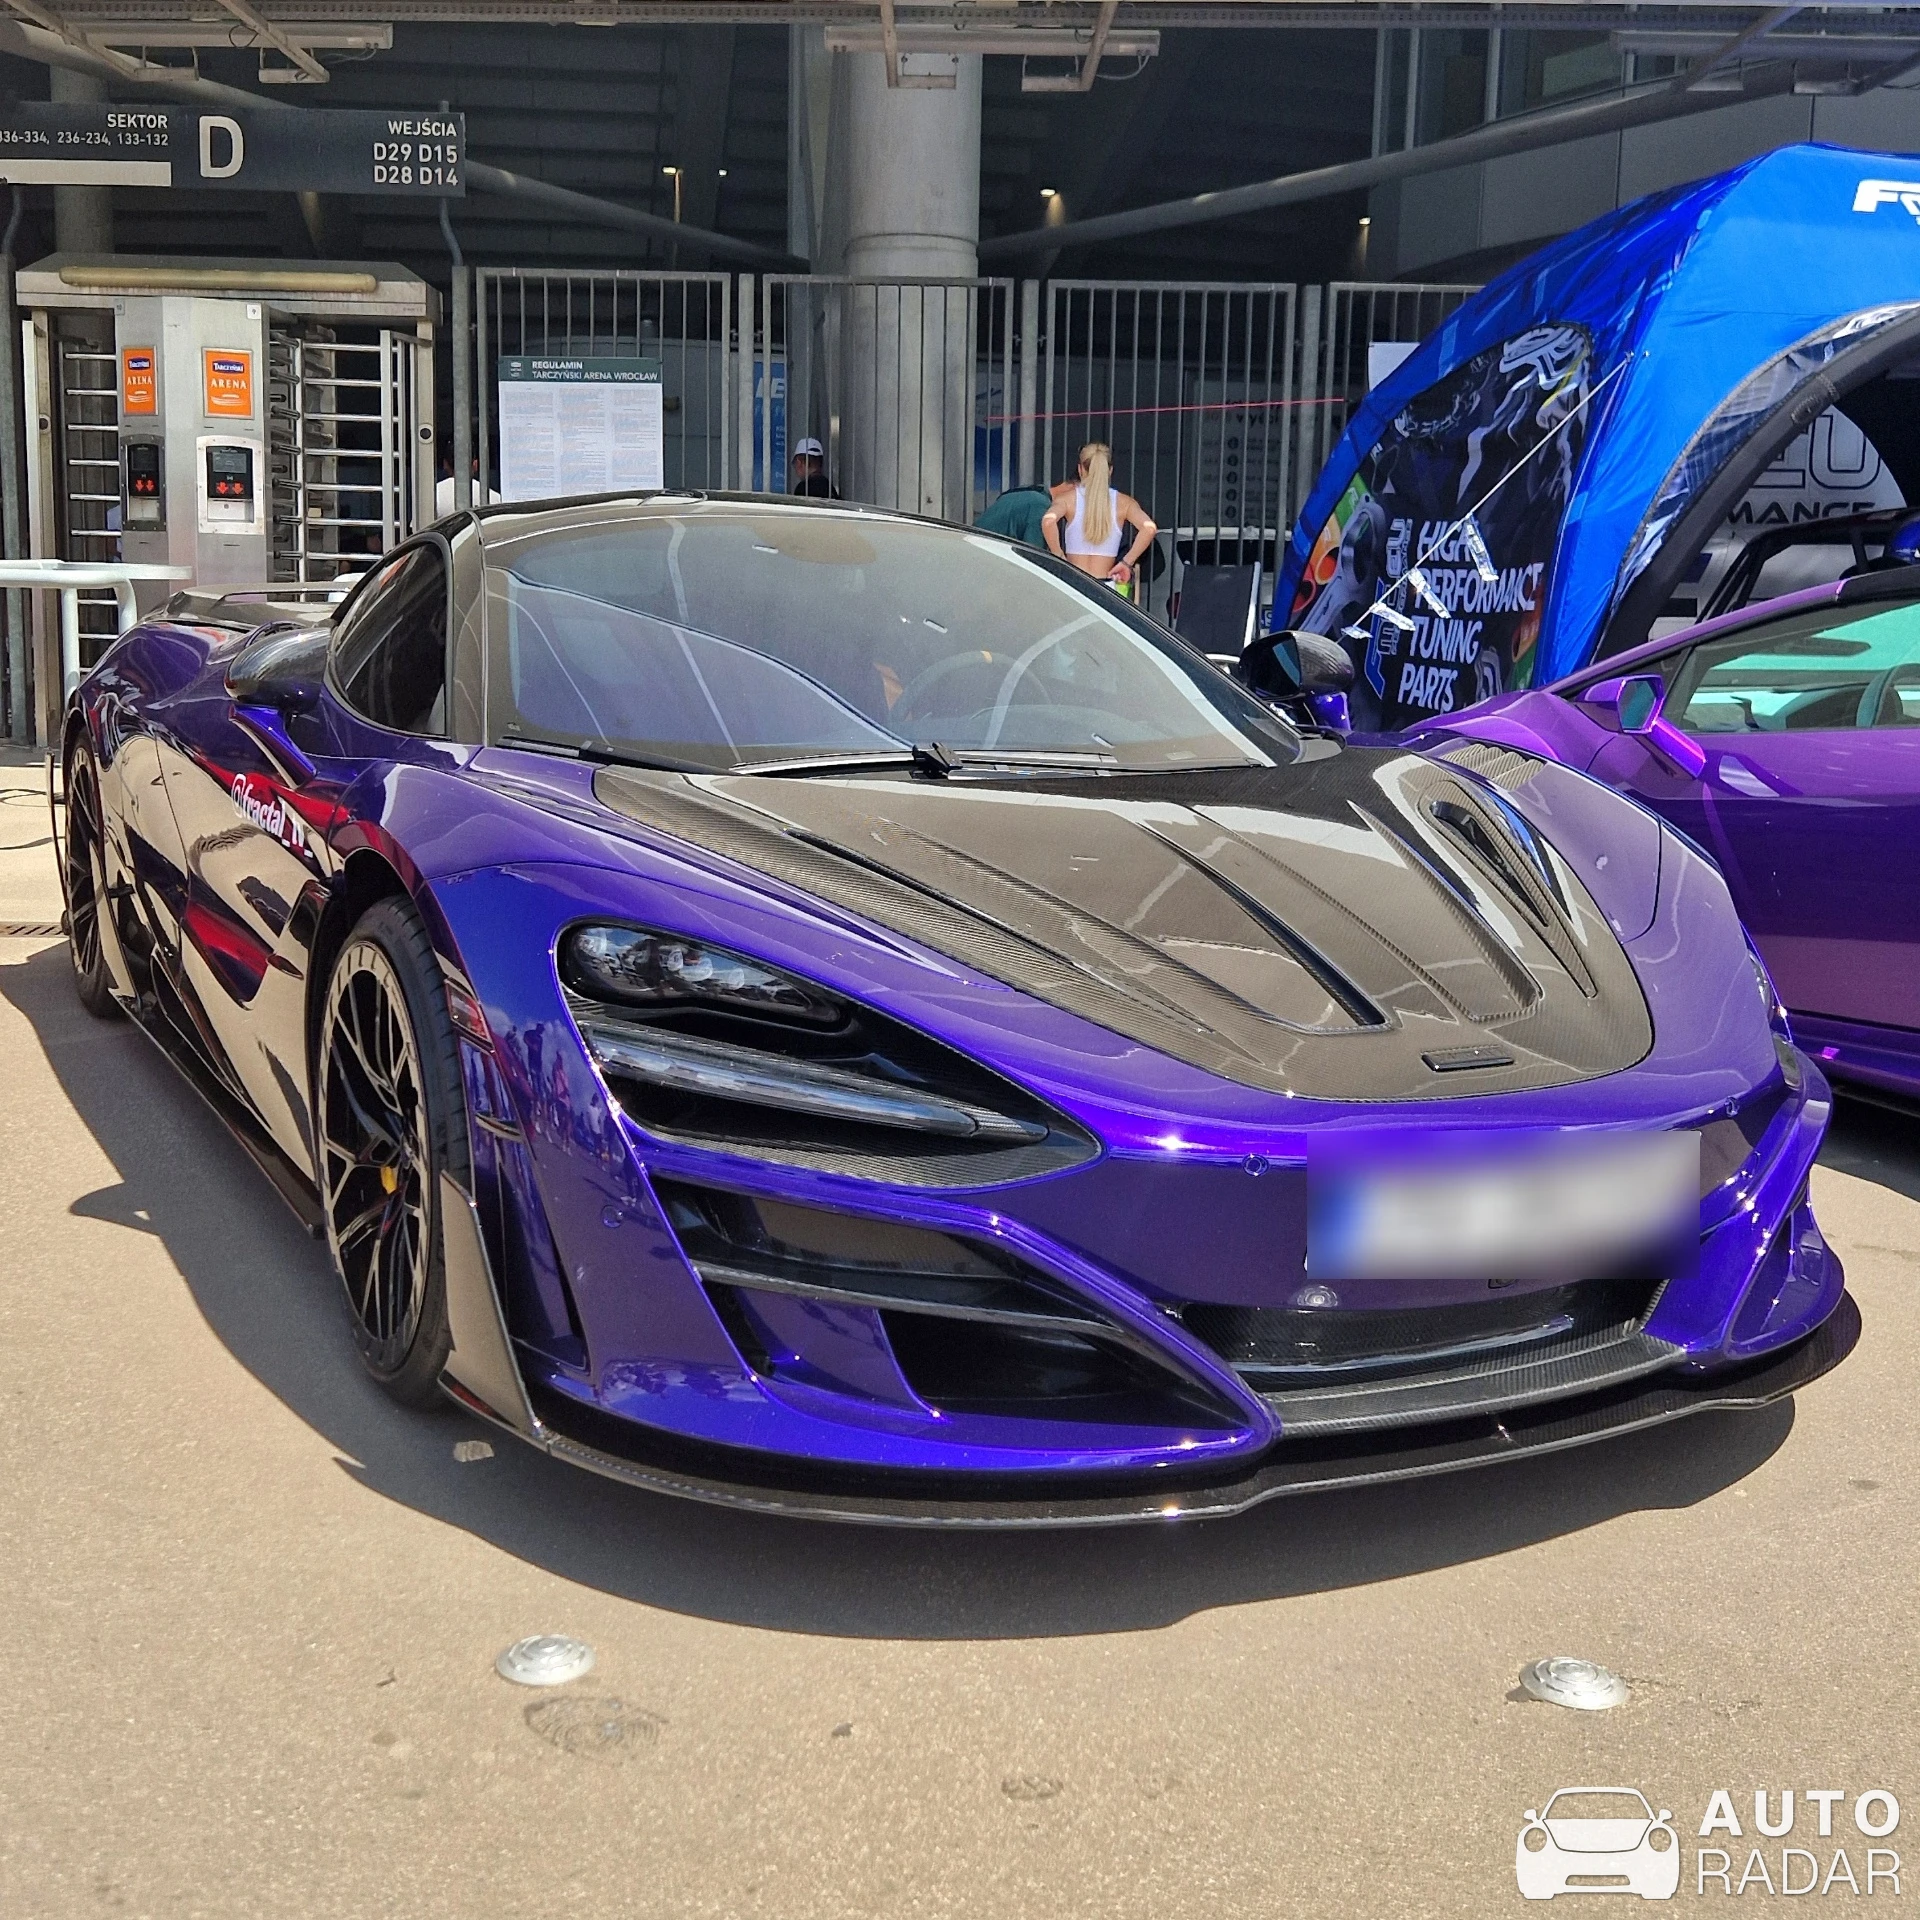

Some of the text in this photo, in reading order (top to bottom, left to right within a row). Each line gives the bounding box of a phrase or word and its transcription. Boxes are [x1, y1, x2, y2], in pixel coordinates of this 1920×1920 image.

[107, 113, 168, 129] SEKTOR
[388, 117, 457, 137] WEJŚCIA
[57, 131, 111, 146] 236-234,
[117, 133, 168, 146] 133-132
[200, 115, 244, 178] D
[374, 142, 458, 164] D29 D15
[374, 165, 459, 186] D28 D14
[532, 361, 583, 370] REGULAMIN
[532, 369, 582, 380] TARCZYŃSKI
[584, 372, 612, 380] ARENA
[614, 372, 658, 381] WROCŁAW
[127, 376, 152, 386] ARENA
[210, 379, 247, 389] ARENA
[1417, 520, 1479, 562] HIG
[1410, 615, 1483, 665] TUNING
[1398, 662, 1460, 714] PARTS
